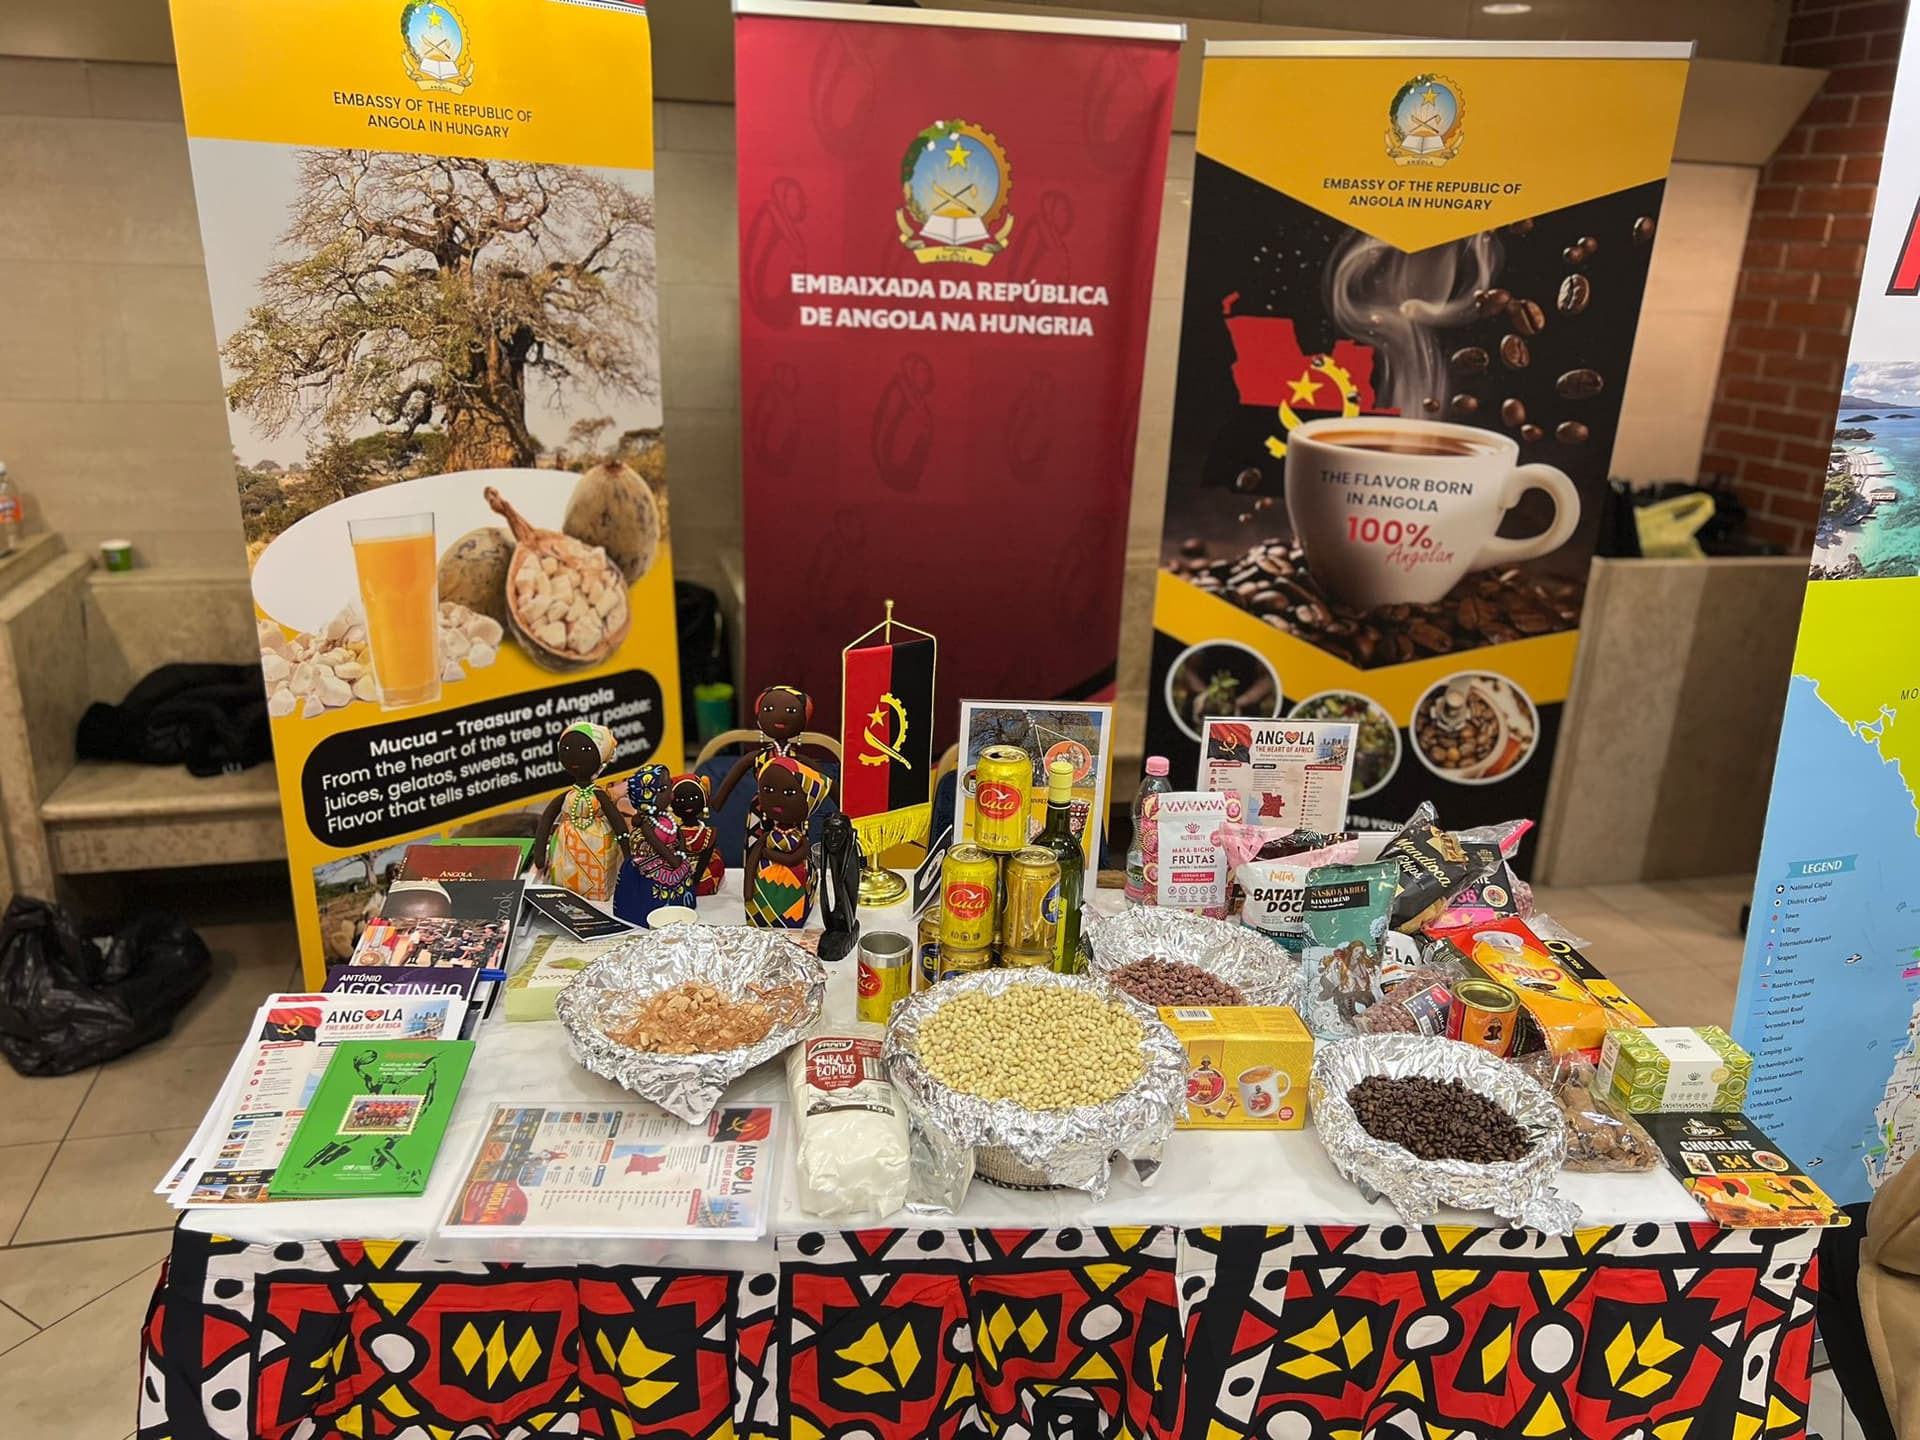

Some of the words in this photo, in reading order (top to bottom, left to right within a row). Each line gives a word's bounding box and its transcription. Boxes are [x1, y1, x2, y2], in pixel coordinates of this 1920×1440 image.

[333, 91, 401, 110] EMBASSY
[405, 98, 423, 112] OF
[426, 100, 451, 115] THE
[454, 104, 513, 121] REPUBLIC
[517, 110, 533, 123] OF
[367, 114, 426, 132] ANGOLA
[430, 119, 442, 133] IN
[446, 121, 509, 138] HUNGARY
[1323, 178, 1385, 191] EMBASSY
[1388, 180, 1406, 191] OF
[1409, 181, 1433, 192] THE
[1436, 181, 1500, 194] REPUBLIC
[1503, 183, 1522, 195] OF
[1349, 195, 1404, 208] ANGOLA
[1407, 197, 1421, 208] IN
[1424, 198, 1493, 211] HUNGARY
[791, 273, 936, 300] EMBAIXADA
[940, 280, 973, 300] DA
[977, 279, 1109, 306] REPÚBLICA
[800, 306, 832, 327] DE
[836, 308, 937, 332] ANGOLA
[941, 313, 976, 332] NA
[980, 314, 1094, 336] HUNGRIA
[1321, 470, 1351, 485] THE
[1354, 473, 1420, 491] FLAVOR
[1423, 479, 1473, 496] BORN
[1346, 492, 1363, 506] IN
[1367, 495, 1438, 512] ANGOLA
[1346, 516, 1433, 549] 100%
[1385, 542, 1455, 572] Angolan
[368, 731, 438, 757] Mucua
[456, 706, 533, 737] Treasure
[535, 699, 553, 717] of
[556, 688, 615, 713] Angola
[322, 767, 371, 791] From
[375, 758, 406, 778] the
[410, 748, 457, 770] heart
[460, 744, 477, 758] of
[480, 735, 507, 752] the
[509, 727, 542, 742] tree
[545, 721, 563, 736] to
[323, 788, 384, 817] juices,
[388, 770, 457, 801] gelatos,
[460, 753, 518, 779] sweets,
[521, 741, 553, 761] and
[327, 809, 384, 834] Flavor
[388, 799, 427, 819] that
[430, 787, 463, 809] tells
[466, 772, 522, 798] stories.
[1352, 815, 1370, 828] TO
[1172, 854, 1215, 865] FRUTAS
[1395, 838, 1452, 888] Mandioca
[1397, 855, 1424, 880] Chips
[1801, 860, 1843, 874] LEGEND
[439, 870, 473, 878] ANGOLA
[948, 888, 985, 910] Cuca
[1254, 888, 1305, 902] BATAT
[1266, 901, 1304, 913] DOC
[339, 973, 382, 982] ANTÓNIO
[339, 1023, 363, 1031] HEART
[376, 1022, 401, 1030] AFRICA
[816, 1063, 857, 1077] BOMBO
[1680, 1140, 1757, 1151] CHOCOLATE
